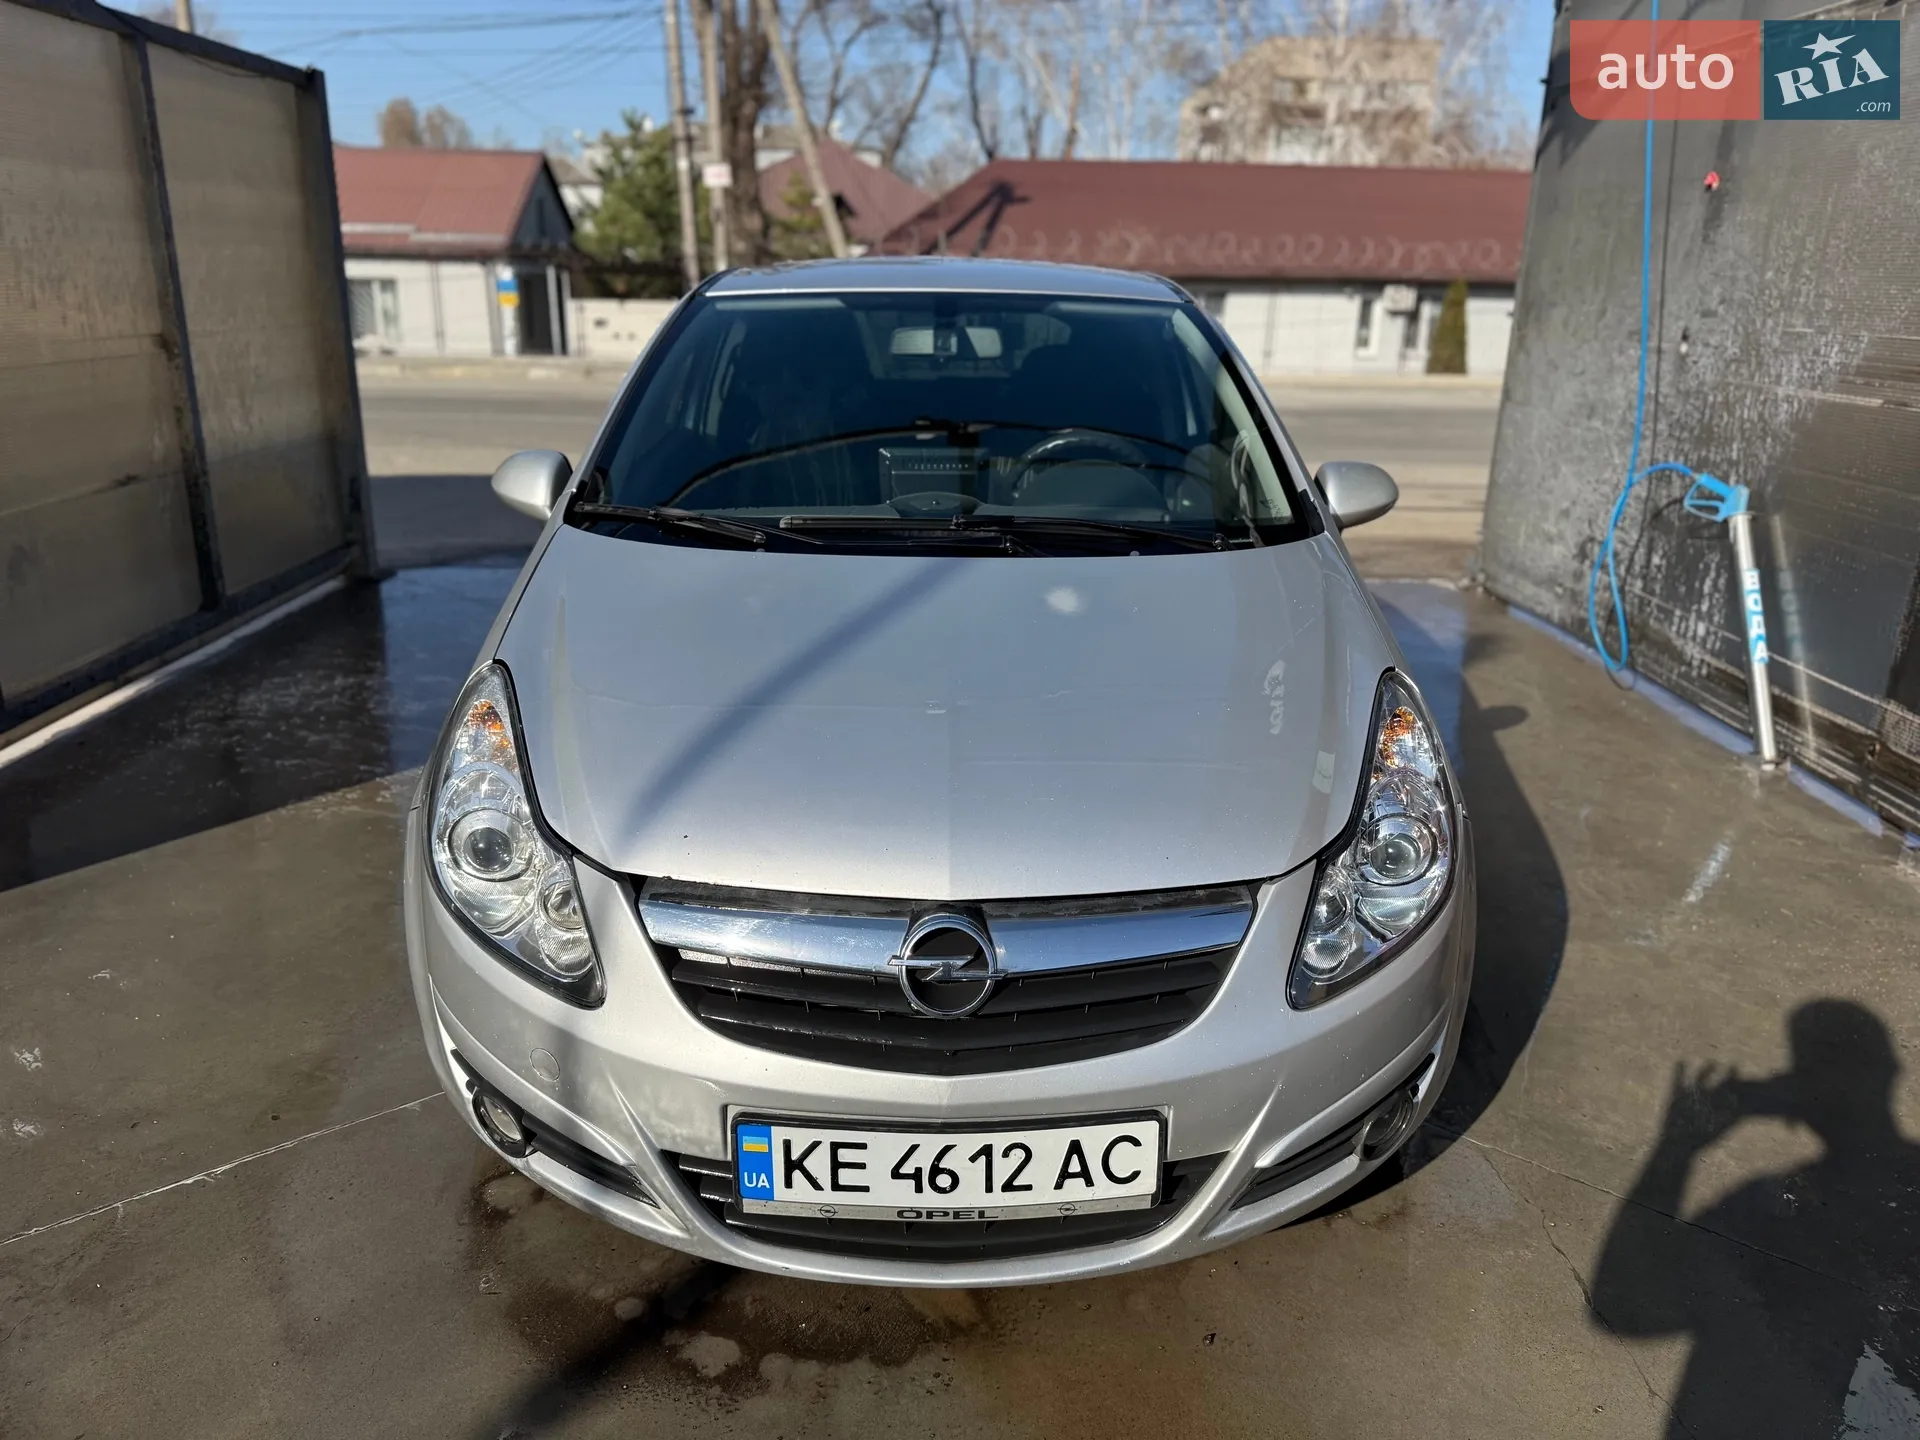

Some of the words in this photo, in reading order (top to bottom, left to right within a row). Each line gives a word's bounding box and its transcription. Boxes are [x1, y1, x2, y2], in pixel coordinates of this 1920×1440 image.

[782, 1138, 871, 1192] KE
[890, 1142, 1034, 1195] 4612
[1053, 1134, 1143, 1191] AC
[744, 1172, 770, 1189] UA
[896, 1208, 999, 1220] OPEL
